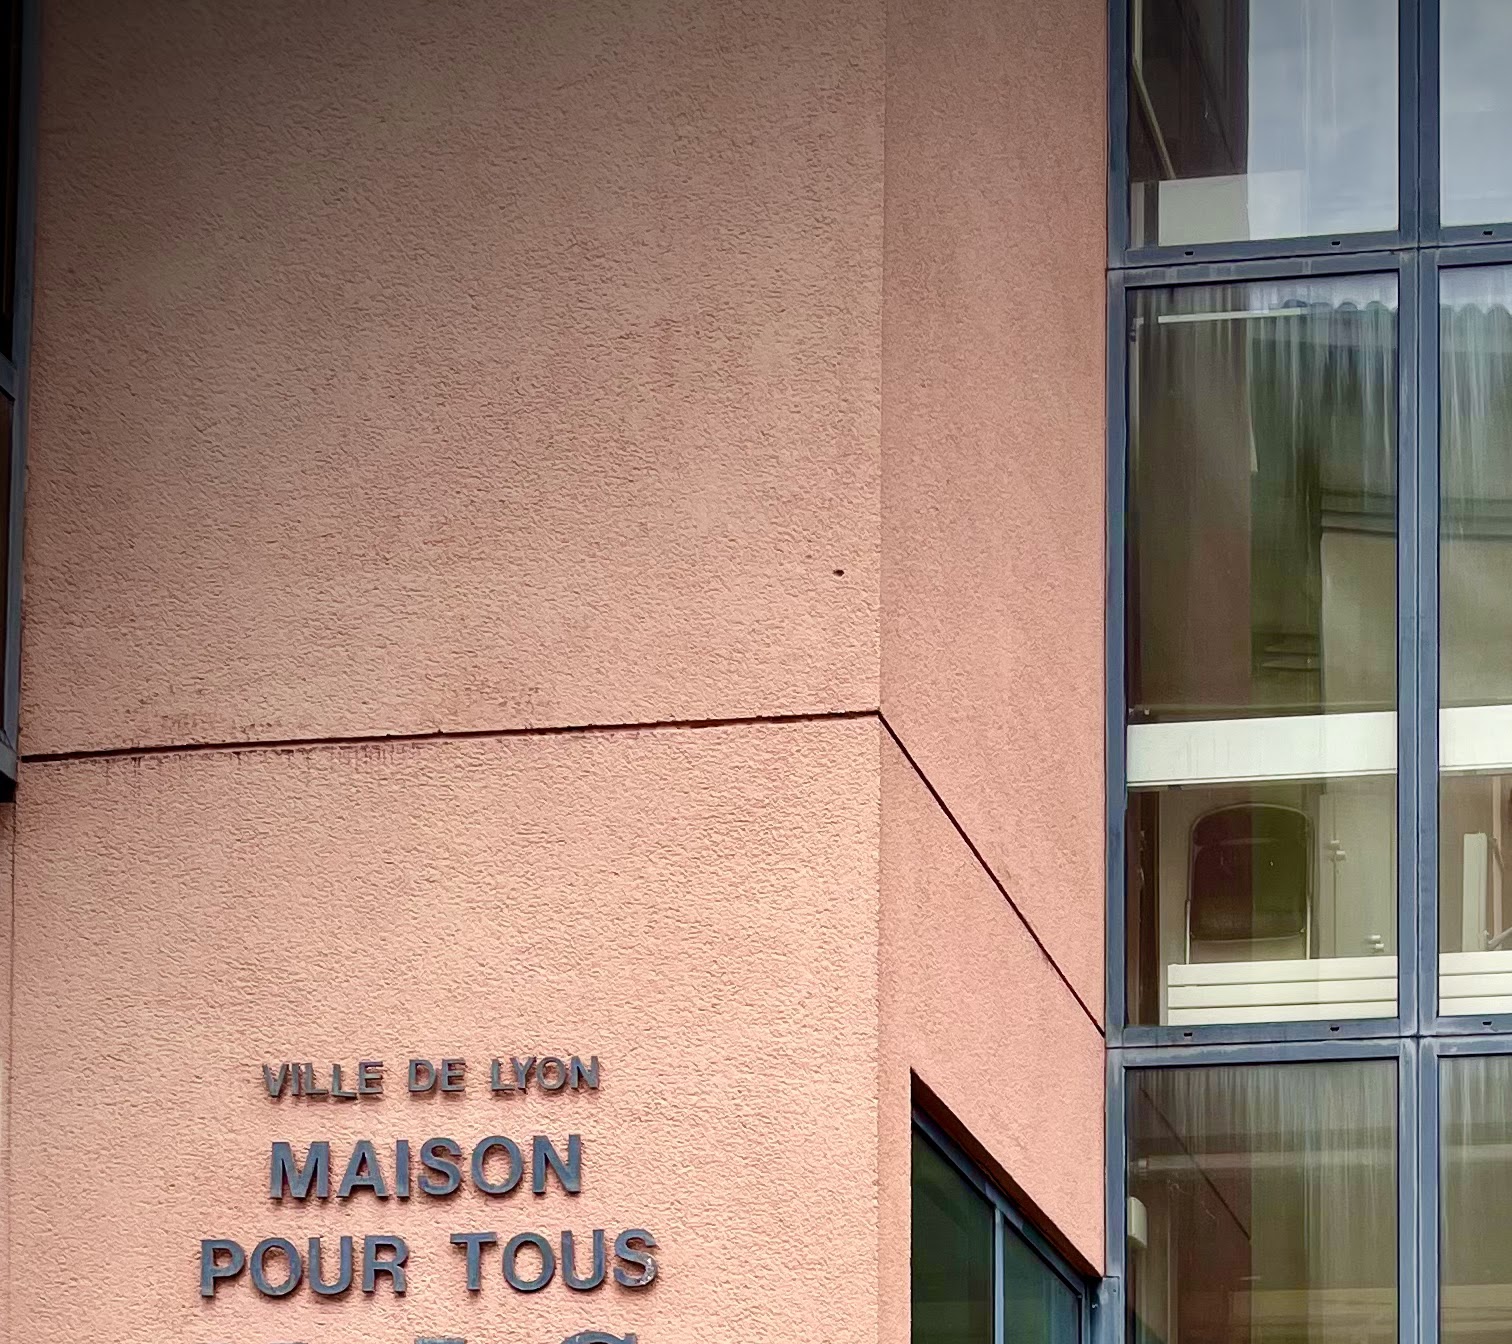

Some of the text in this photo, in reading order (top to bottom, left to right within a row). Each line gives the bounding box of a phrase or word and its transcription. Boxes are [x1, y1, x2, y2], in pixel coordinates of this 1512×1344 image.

[261, 1055, 600, 1098] VILLE DE LYON
[269, 1133, 582, 1201] MAISON
[200, 1227, 659, 1297] POUR TOUS
